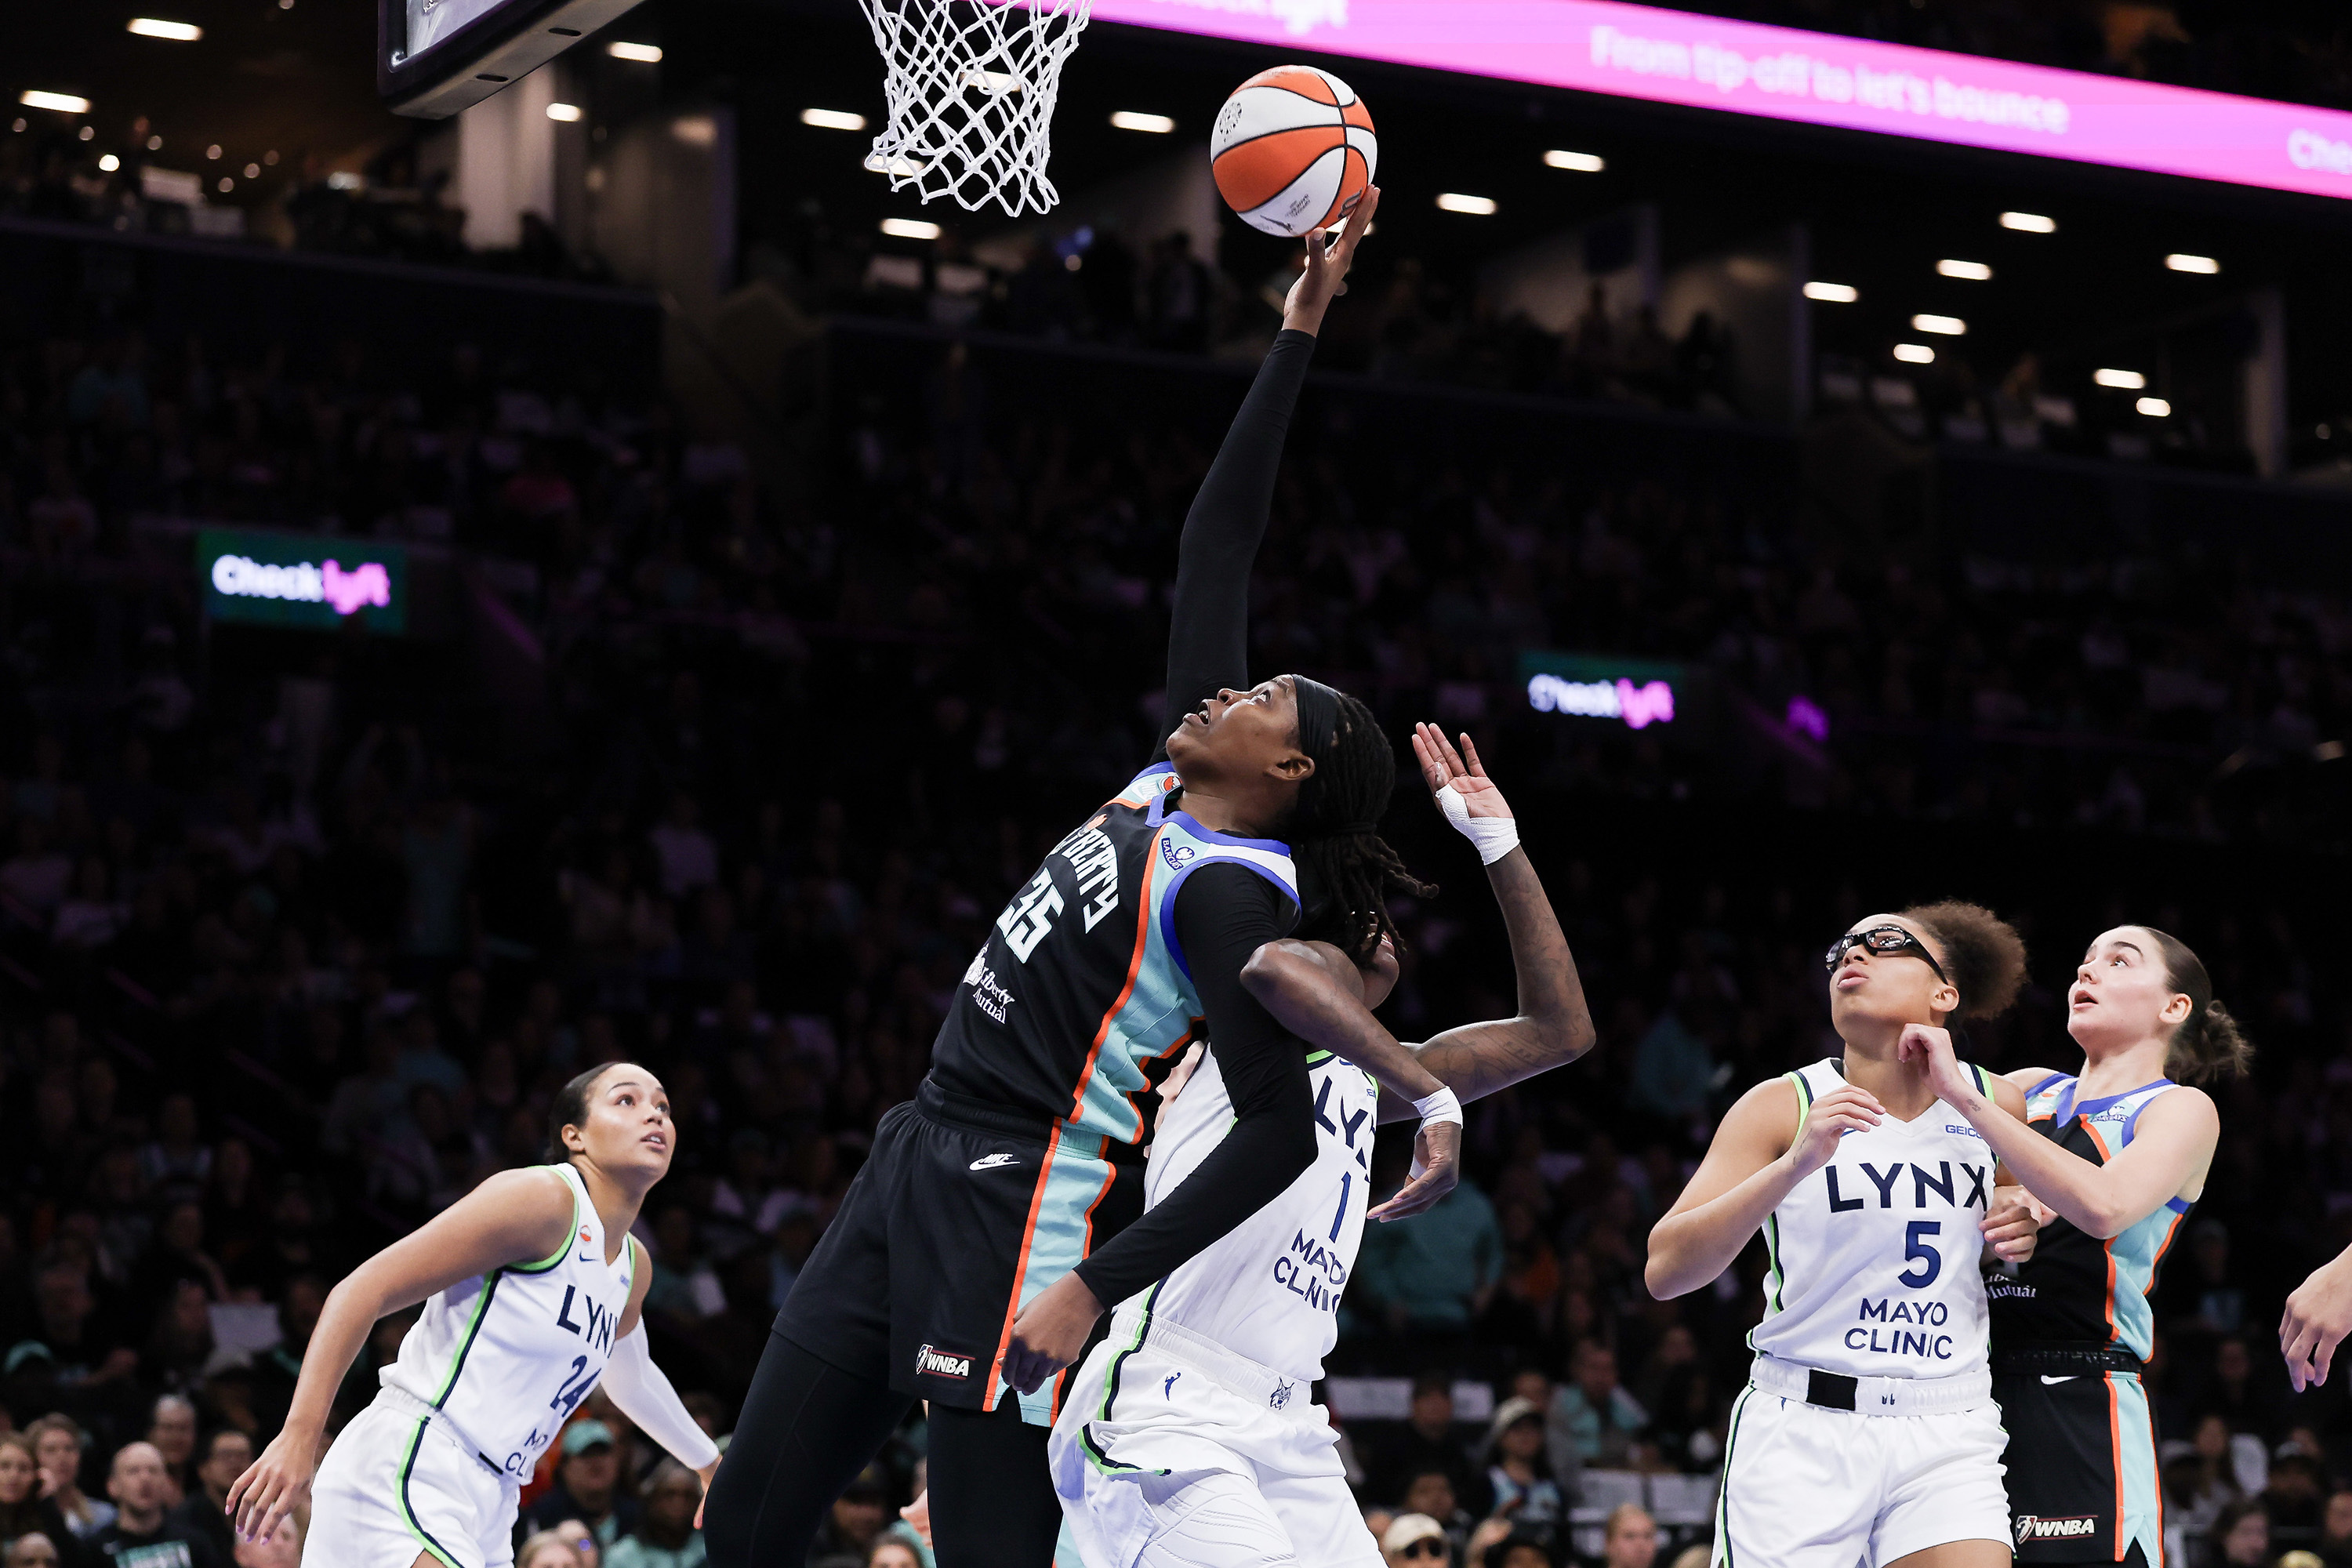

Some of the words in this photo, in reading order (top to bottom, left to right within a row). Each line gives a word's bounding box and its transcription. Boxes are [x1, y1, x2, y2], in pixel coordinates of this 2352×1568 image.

[1591, 25, 1691, 80] From
[1692, 40, 1810, 97] tip-off
[1813, 59, 1853, 103] to
[1854, 63, 1932, 115] let's
[1933, 75, 2070, 136] bounce
[212, 554, 324, 603] Check
[1328, 1171, 1352, 1243] 1
[1825, 1161, 1987, 1213] LYNX
[1897, 1221, 1942, 1288] 5
[1860, 1298, 1949, 1327] MAYO
[927, 1353, 970, 1377] WNBA
[1845, 1328, 1954, 1359] CLINIC
[550, 1355, 601, 1417] 24
[2035, 1519, 2095, 1537] WNBA
